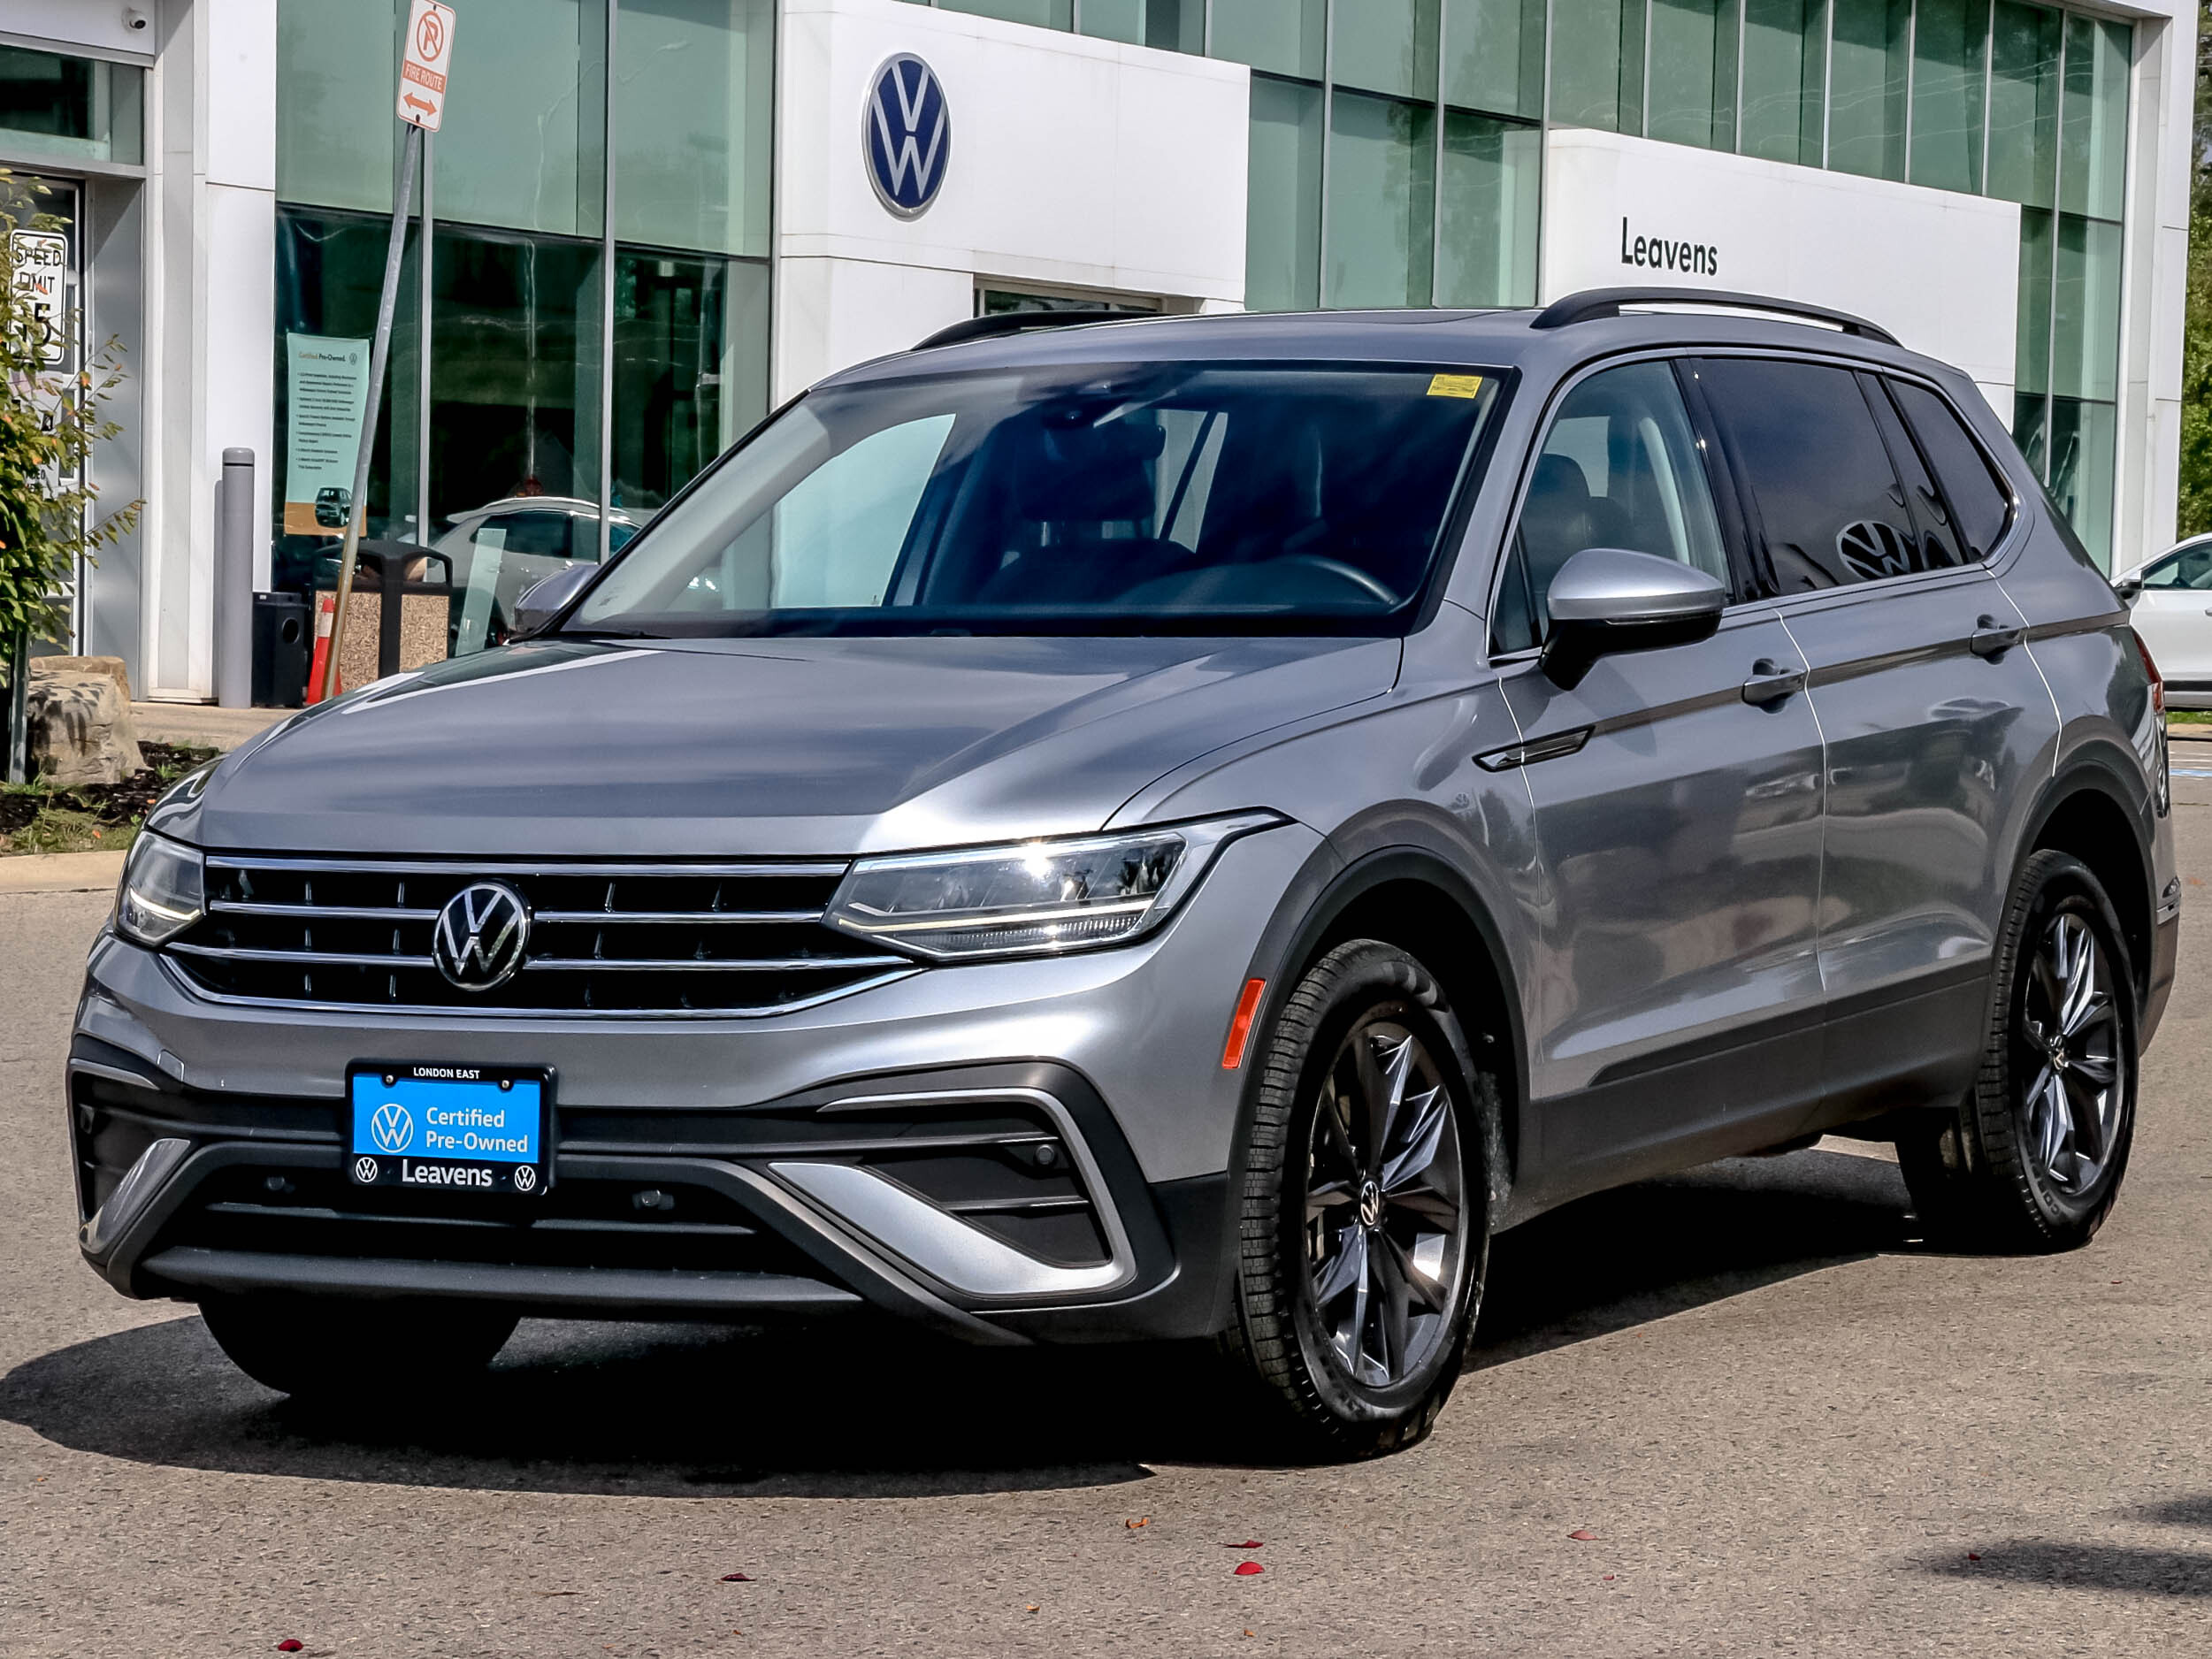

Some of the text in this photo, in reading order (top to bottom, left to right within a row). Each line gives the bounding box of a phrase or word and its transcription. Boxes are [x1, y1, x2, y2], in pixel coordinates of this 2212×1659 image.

[406, 63, 443, 90] FIRE ROUTE
[16, 247, 62, 266] SPEED
[1621, 216, 1718, 276] Leavens
[413, 1066, 480, 1080] LONDON EAST
[425, 1106, 505, 1128] Certified
[425, 1130, 528, 1153] Pre-Owned
[402, 1158, 493, 1187] Leavens
